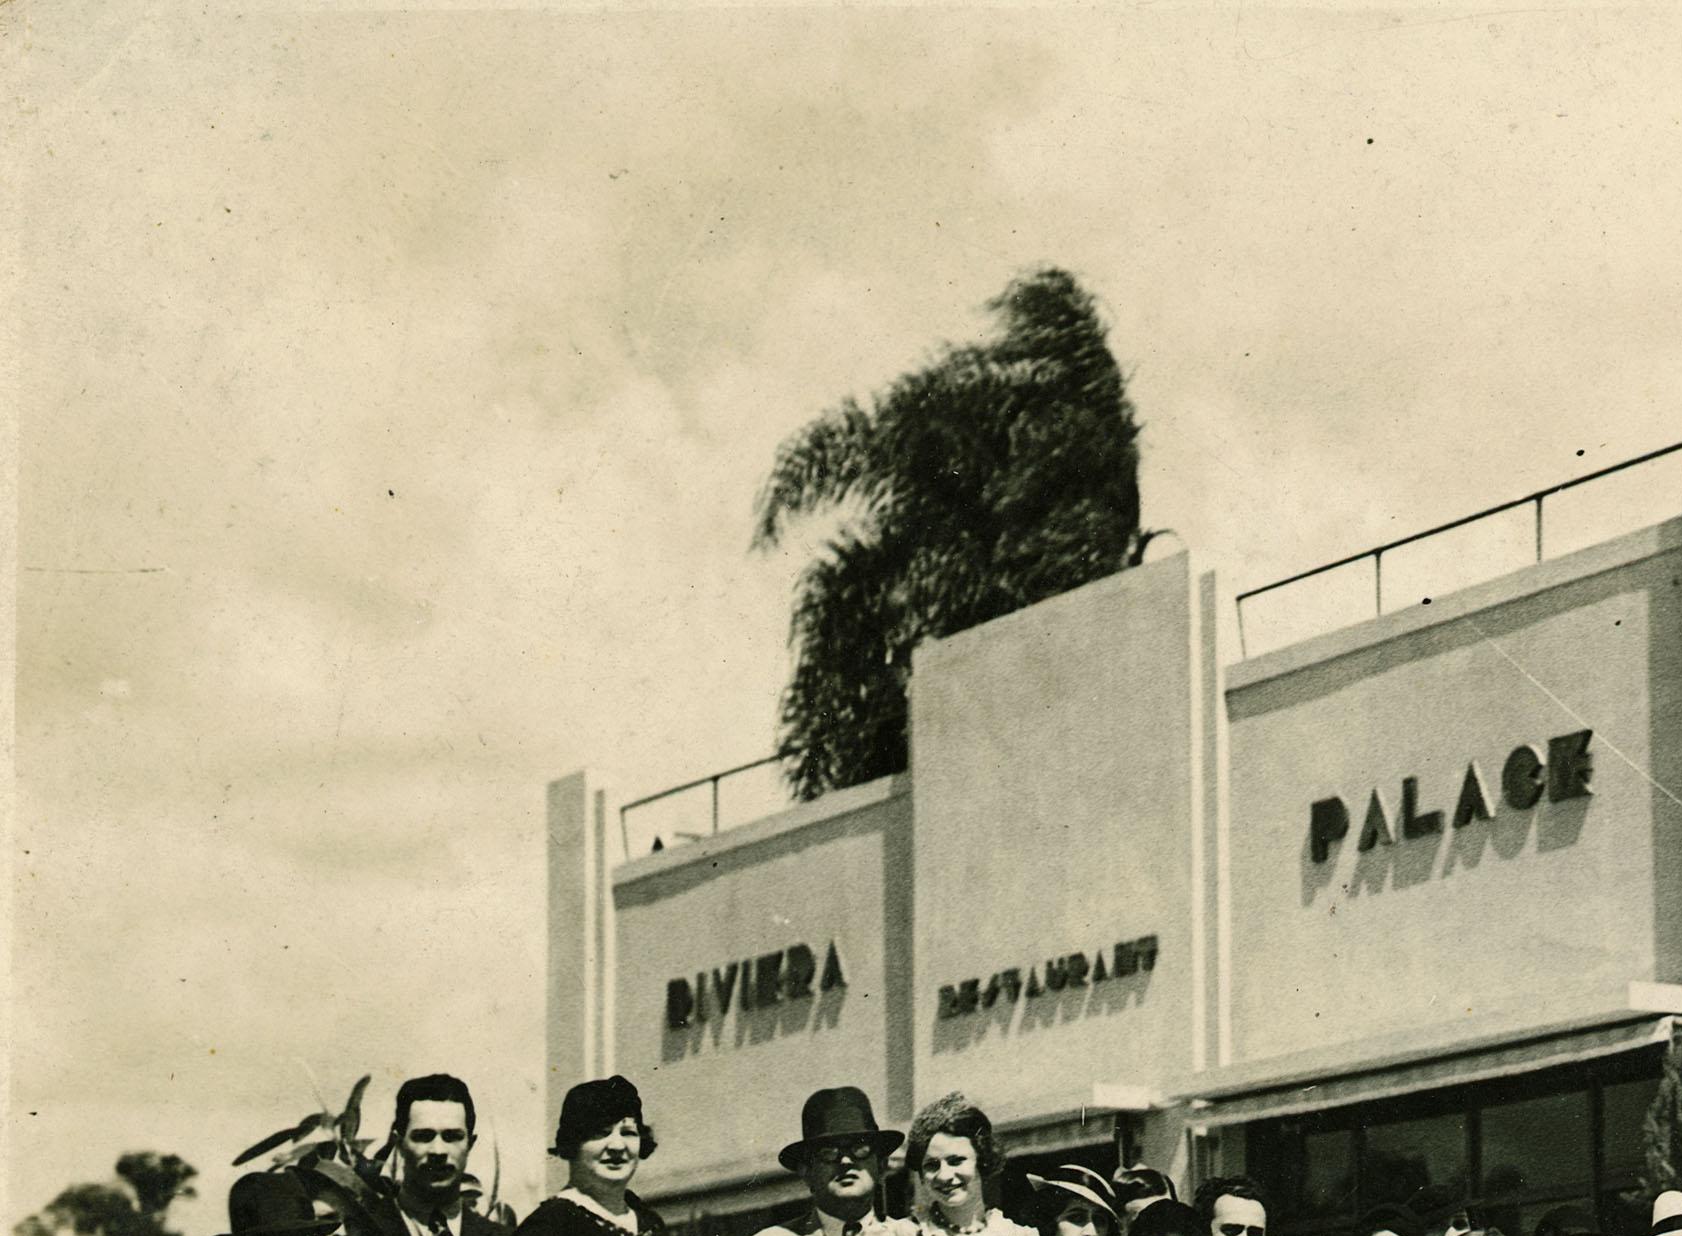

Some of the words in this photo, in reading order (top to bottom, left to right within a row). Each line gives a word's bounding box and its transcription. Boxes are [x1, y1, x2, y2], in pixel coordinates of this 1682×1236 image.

[667, 938, 848, 1031] RIVIERA
[938, 934, 1158, 1020] RESTAURANT
[1310, 728, 1595, 863] PALACE
